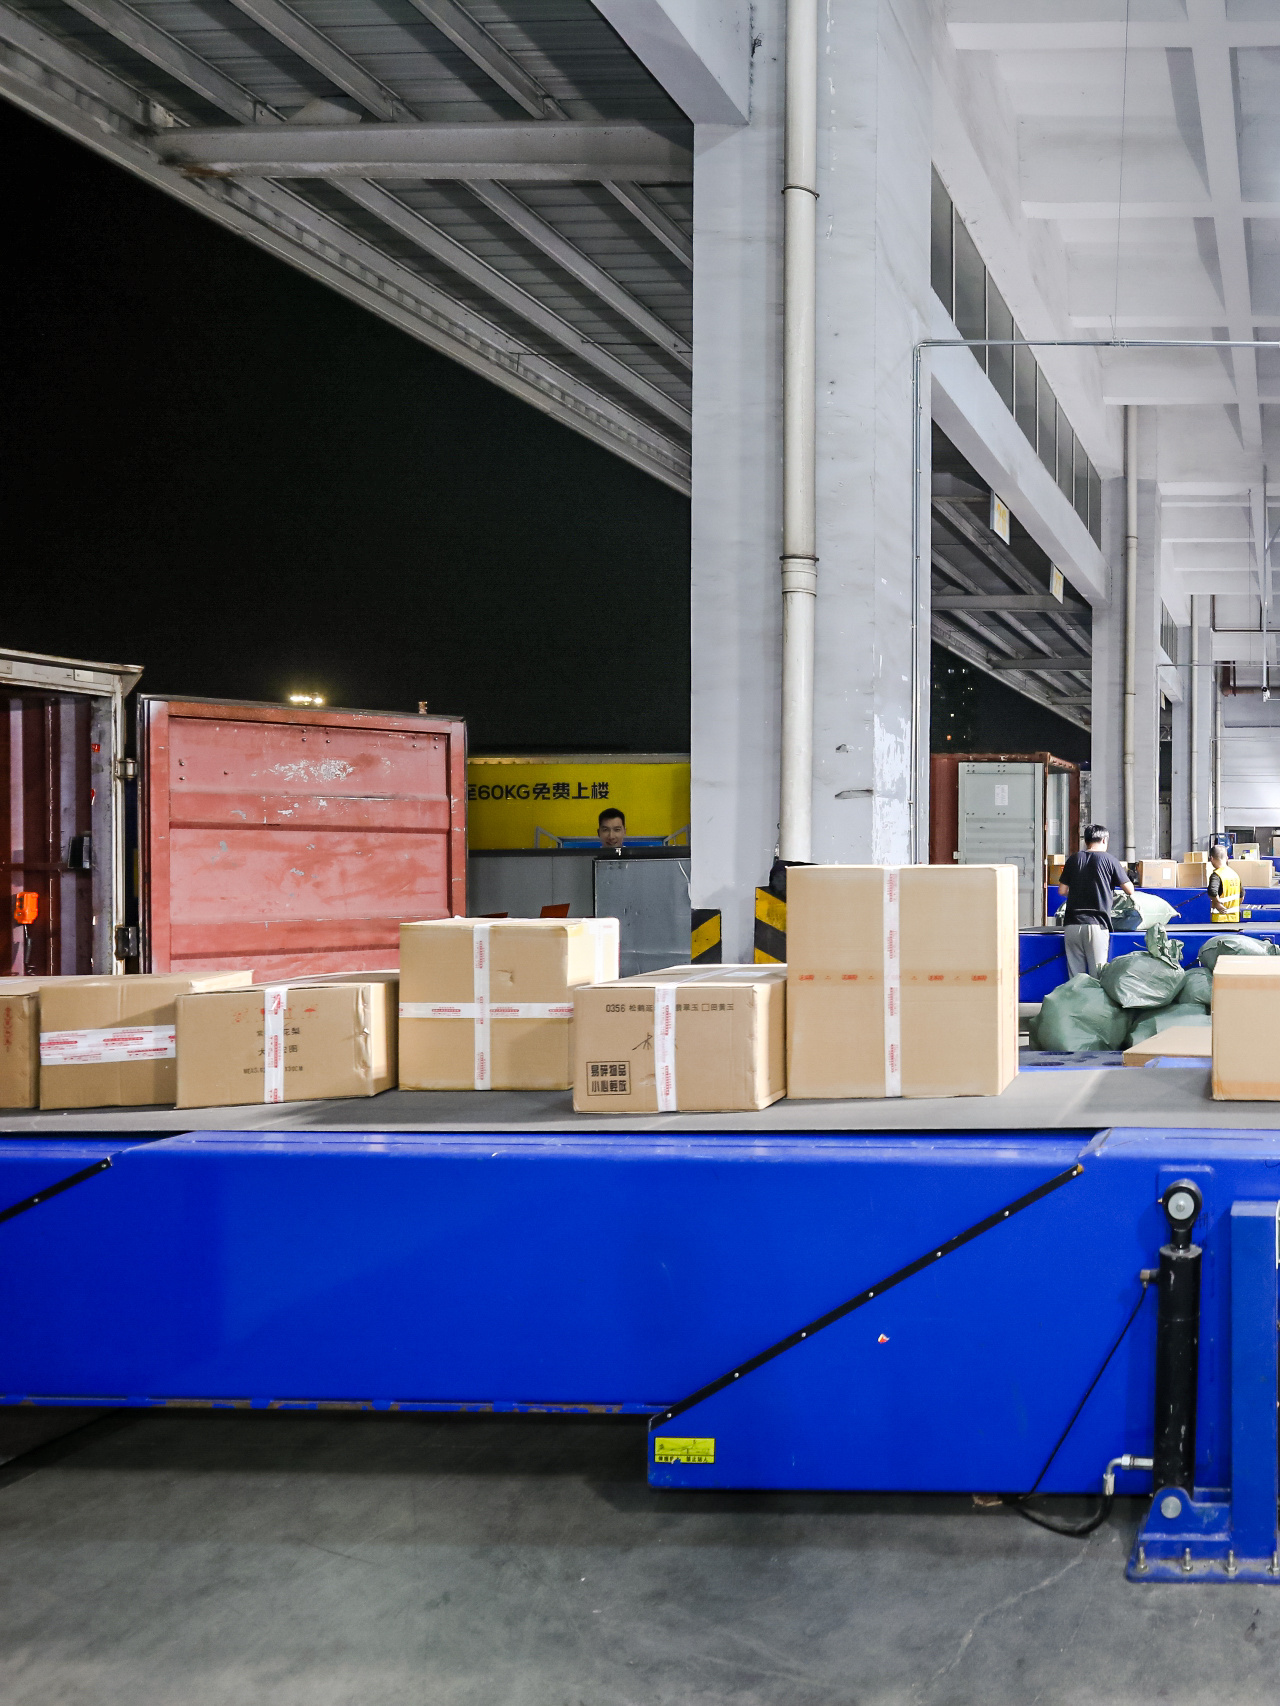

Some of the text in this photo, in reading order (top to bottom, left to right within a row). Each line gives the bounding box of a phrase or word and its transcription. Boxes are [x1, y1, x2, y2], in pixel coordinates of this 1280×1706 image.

[605, 1003, 625, 1013] 0356
[591, 1064, 627, 1077] 易碎物品
